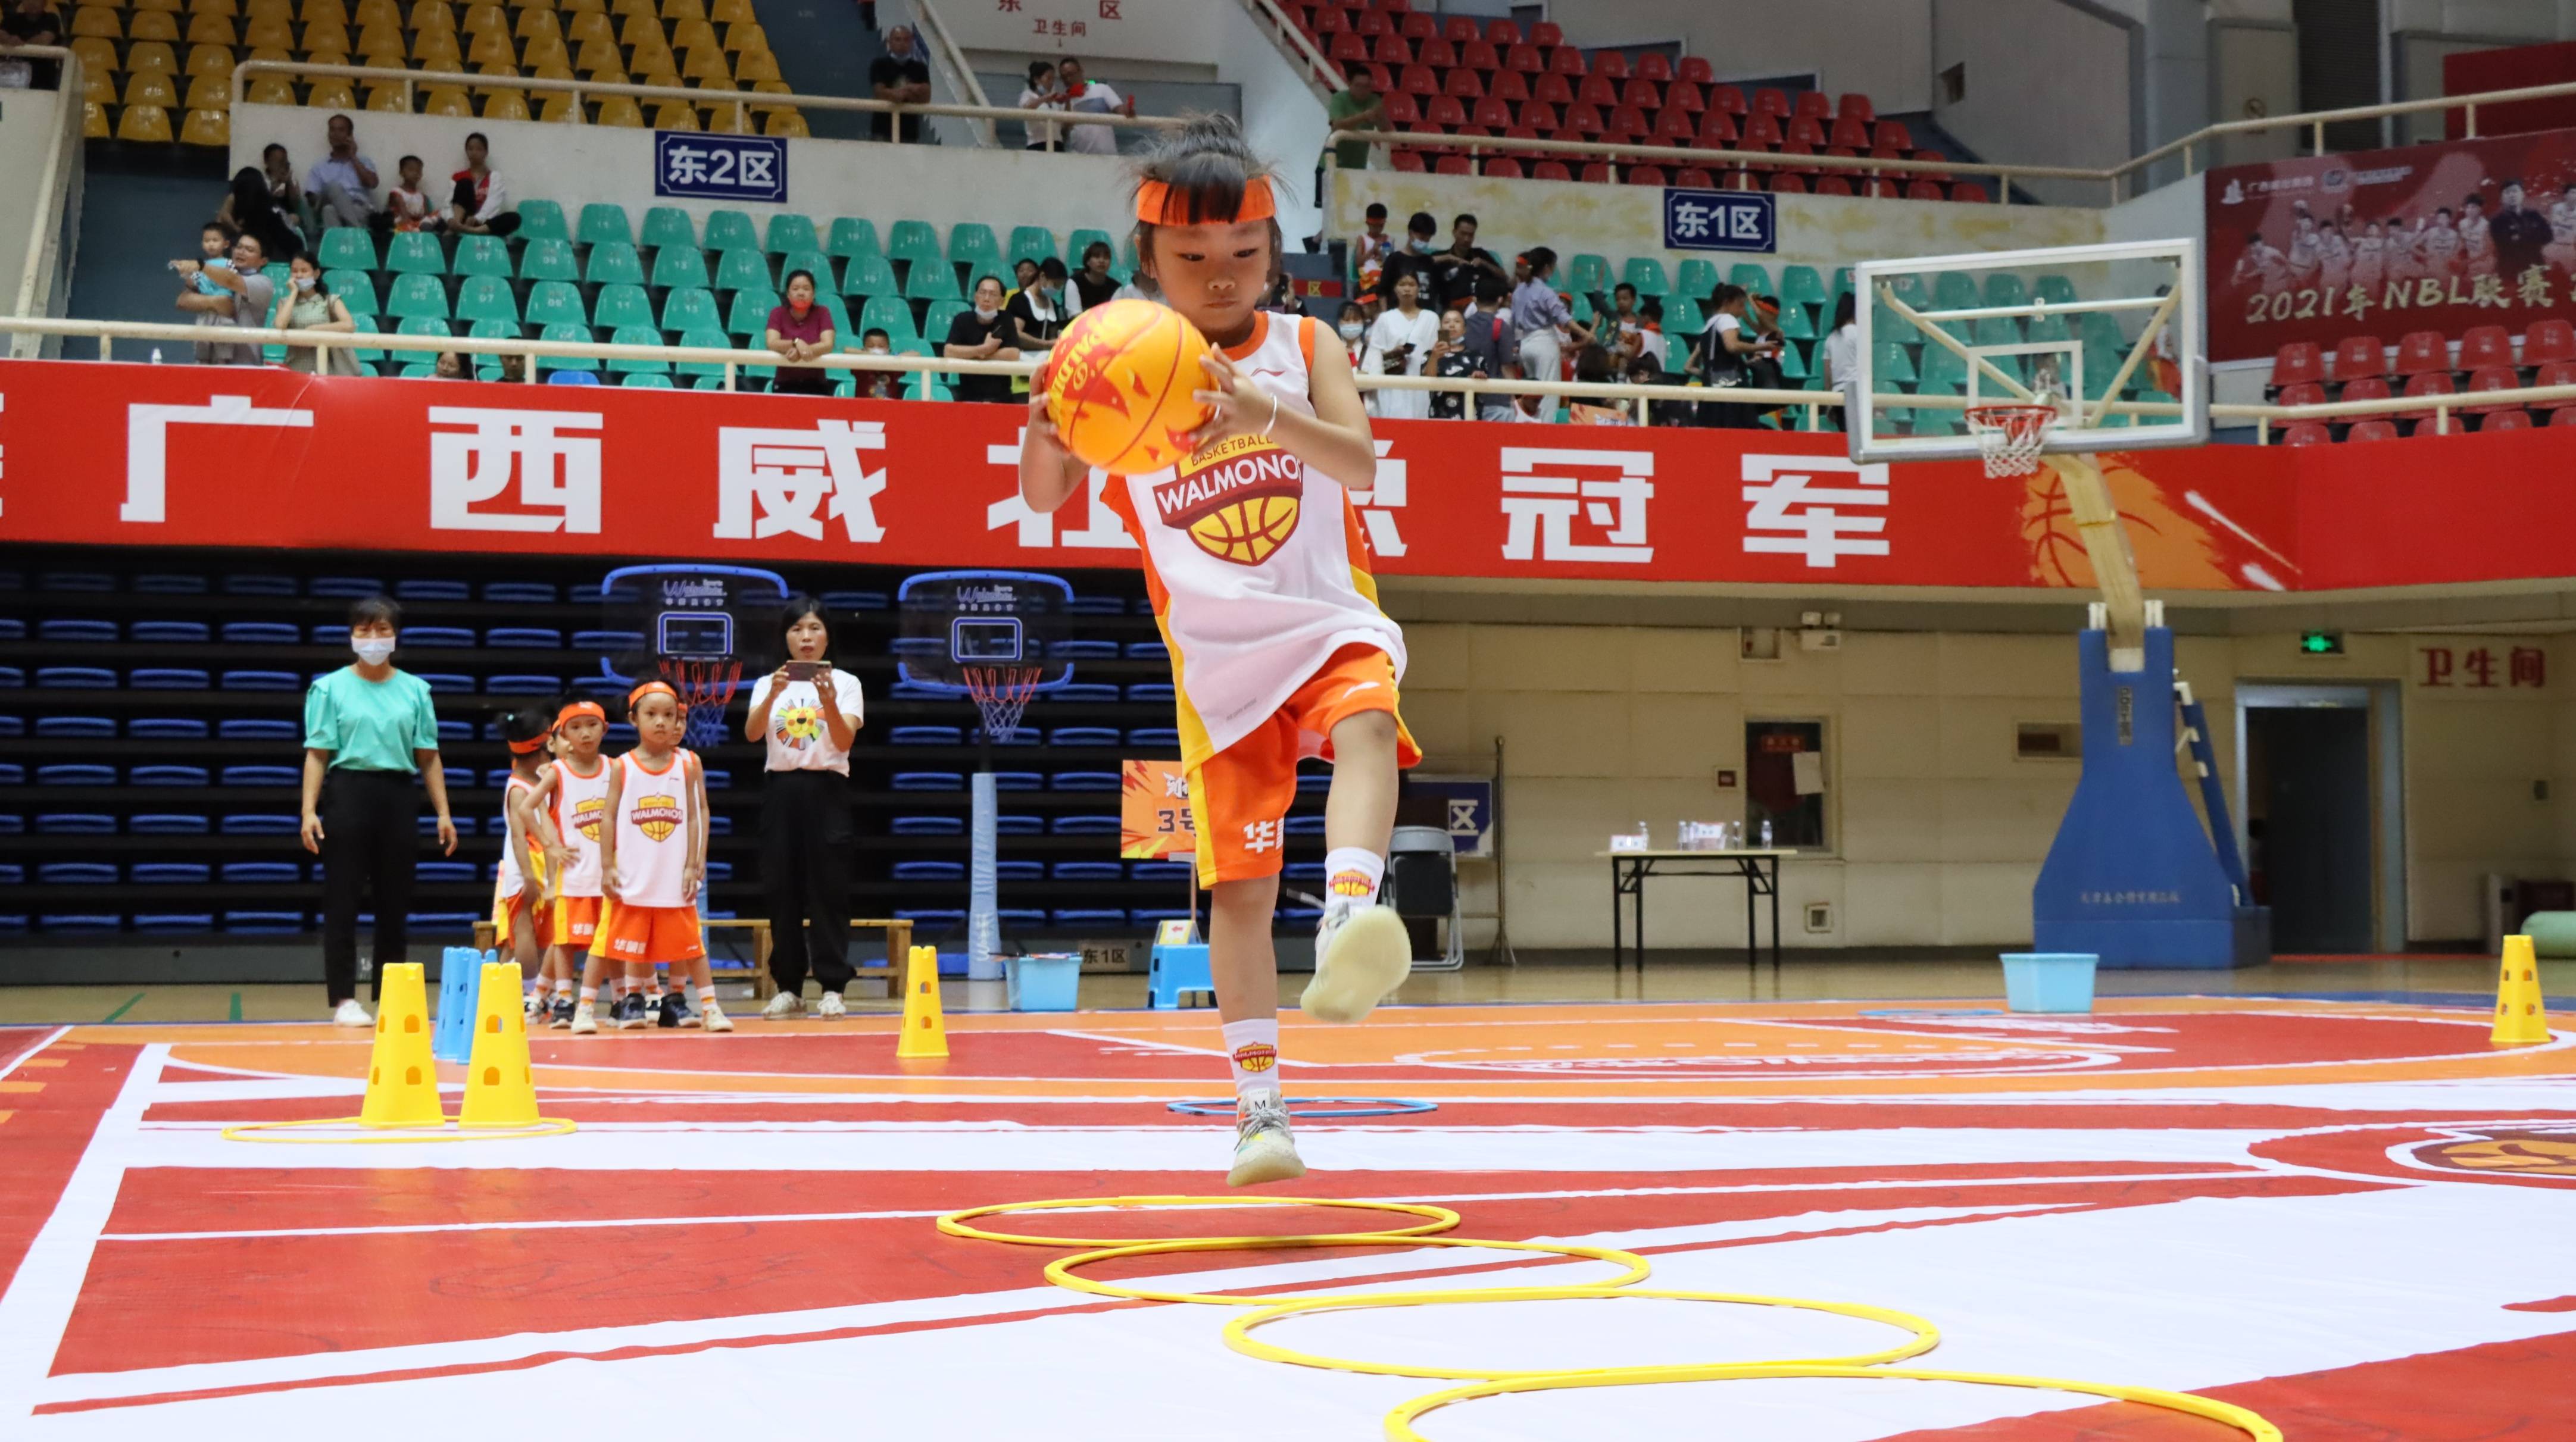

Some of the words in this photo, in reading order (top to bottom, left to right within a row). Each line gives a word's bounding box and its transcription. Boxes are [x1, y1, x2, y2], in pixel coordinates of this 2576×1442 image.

[1033, 18, 1086, 37] 卫生间
[668, 145, 775, 187] 东2区
[1674, 202, 1762, 240] 东1区
[2246, 264, 2576, 324] 2021年NBL联赛
[1157, 453, 1302, 515] WALMONO
[2418, 646, 2546, 689] 卫生间
[631, 807, 683, 821] WALMONOS
[1084, 947, 1126, 965] 东1区
